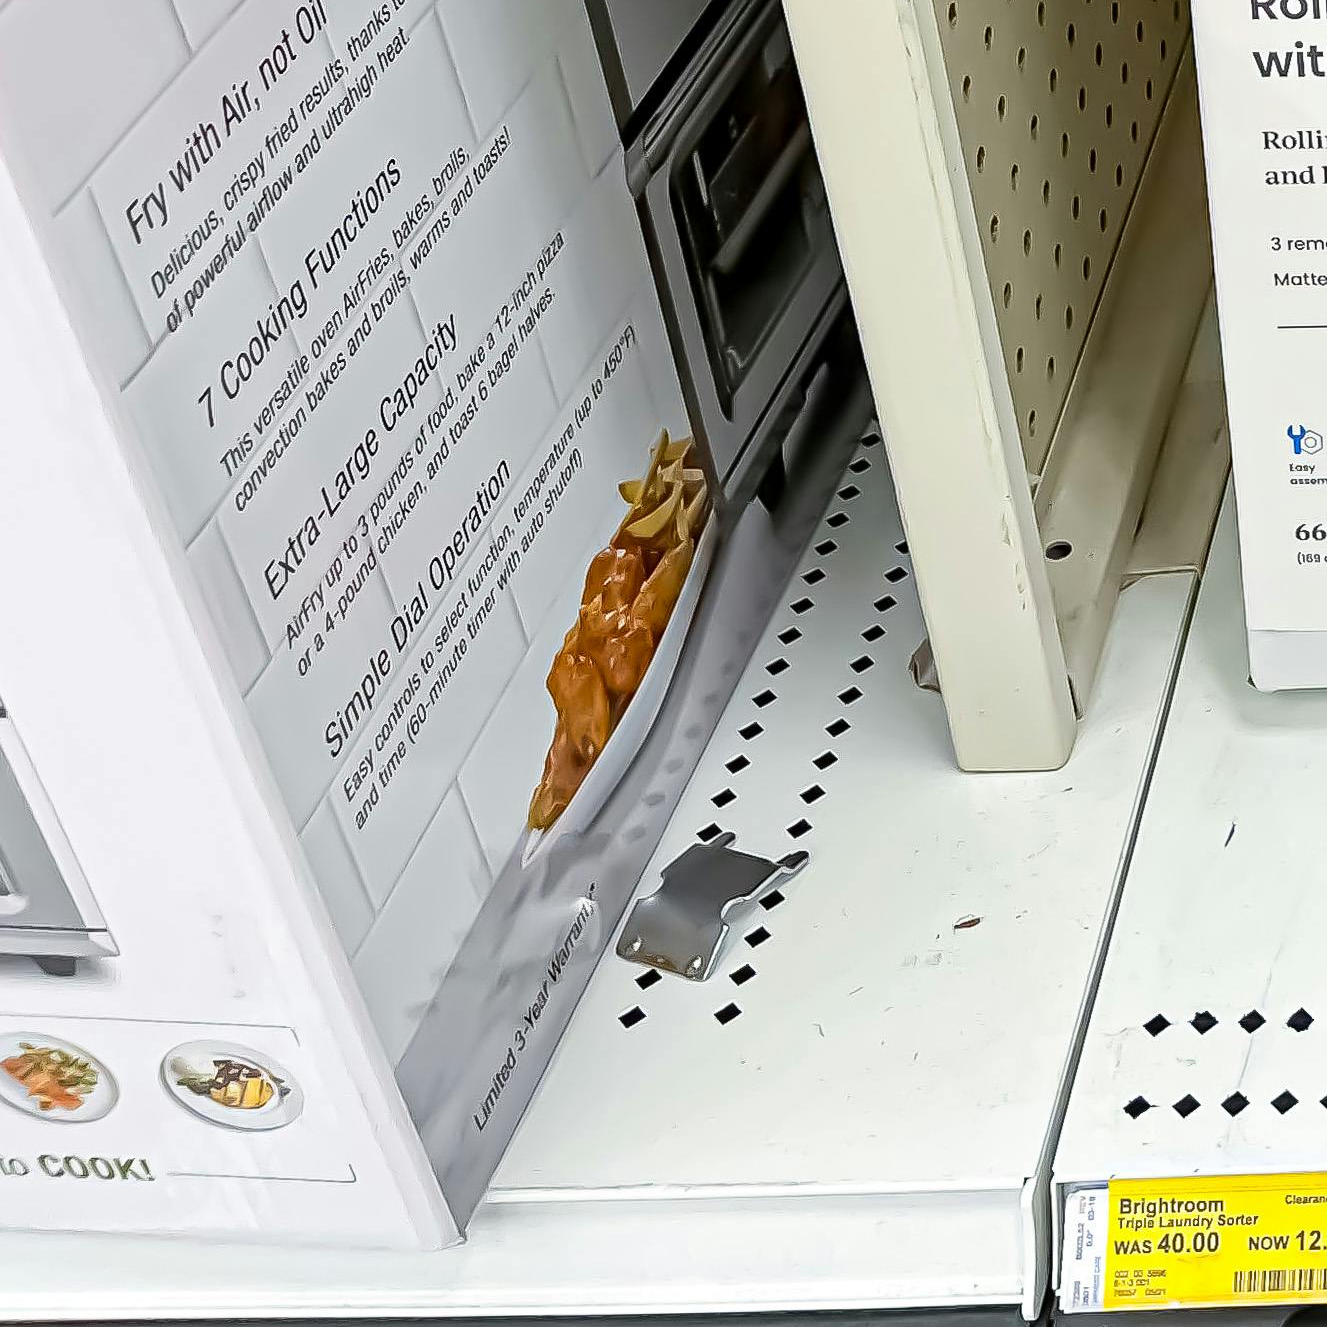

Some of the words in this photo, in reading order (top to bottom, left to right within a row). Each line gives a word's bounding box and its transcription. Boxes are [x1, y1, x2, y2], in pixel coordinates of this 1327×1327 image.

[126, 183, 168, 244] Fry
[169, 123, 221, 192] with
[222, 81, 260, 137] Air,
[259, 30, 297, 91] not
[184, 221, 246, 316] powerful
[247, 165, 293, 232] airflow
[321, 65, 377, 139] ultrahigh
[377, 27, 410, 72] heat.
[299, 59, 349, 120] results,
[347, 4, 391, 61] thanks
[1265, 165, 1316, 186] and
[198, 387, 214, 428] 7
[221, 281, 307, 399] Cooking
[305, 159, 400, 288] Functions
[220, 432, 253, 477] This
[254, 355, 310, 434] versatile
[311, 311, 343, 359] oven
[343, 248, 394, 318] AirFries,
[392, 195, 434, 249] bakes,
[432, 147, 470, 196] broils,
[236, 408, 306, 511] convection
[305, 353, 346, 411] bakes
[371, 264, 411, 322] broils,
[410, 211, 450, 269] warms
[1274, 272, 1327, 287] Matte
[265, 430, 378, 599] Extra-Large
[380, 315, 456, 431] Capacity
[285, 582, 324, 649] AirFry
[370, 452, 414, 526] pounds
[427, 386, 458, 434] food,
[456, 346, 485, 391] bake
[494, 272, 537, 333] 12-inch
[537, 233, 564, 281] pizza
[326, 546, 377, 632] 4-pound
[378, 481, 427, 554] chicken,
[449, 395, 479, 444] toast
[487, 334, 519, 387] bagel
[518, 288, 555, 342] halves.
[1288, 462, 1316, 475] Easy
[326, 650, 390, 757] Simple
[391, 582, 428, 653] Dial
[429, 461, 509, 590] Operation
[344, 749, 374, 802] Easy
[375, 673, 421, 751] controls
[435, 592, 468, 653] select
[468, 525, 515, 597] function,
[514, 424, 574, 523] temperature
[379, 741, 406, 788] time
[467, 588, 495, 639] timer
[497, 550, 520, 590] with
[521, 512, 544, 553] auto
[37, 1154, 155, 1181] COOK!
[473, 1047, 517, 1131] Limited
[514, 980, 551, 1051] 3-Year
[1114, 1239, 1152, 1255] WAS
[1157, 1231, 1220, 1254] 40.00
[1248, 1235, 1290, 1251] NOW
[1118, 1217, 1154, 1232] Triple
[1159, 1215, 1213, 1229] Laundry
[1218, 1214, 1259, 1226] Sorter
[1119, 1197, 1224, 1217] Brightroom
